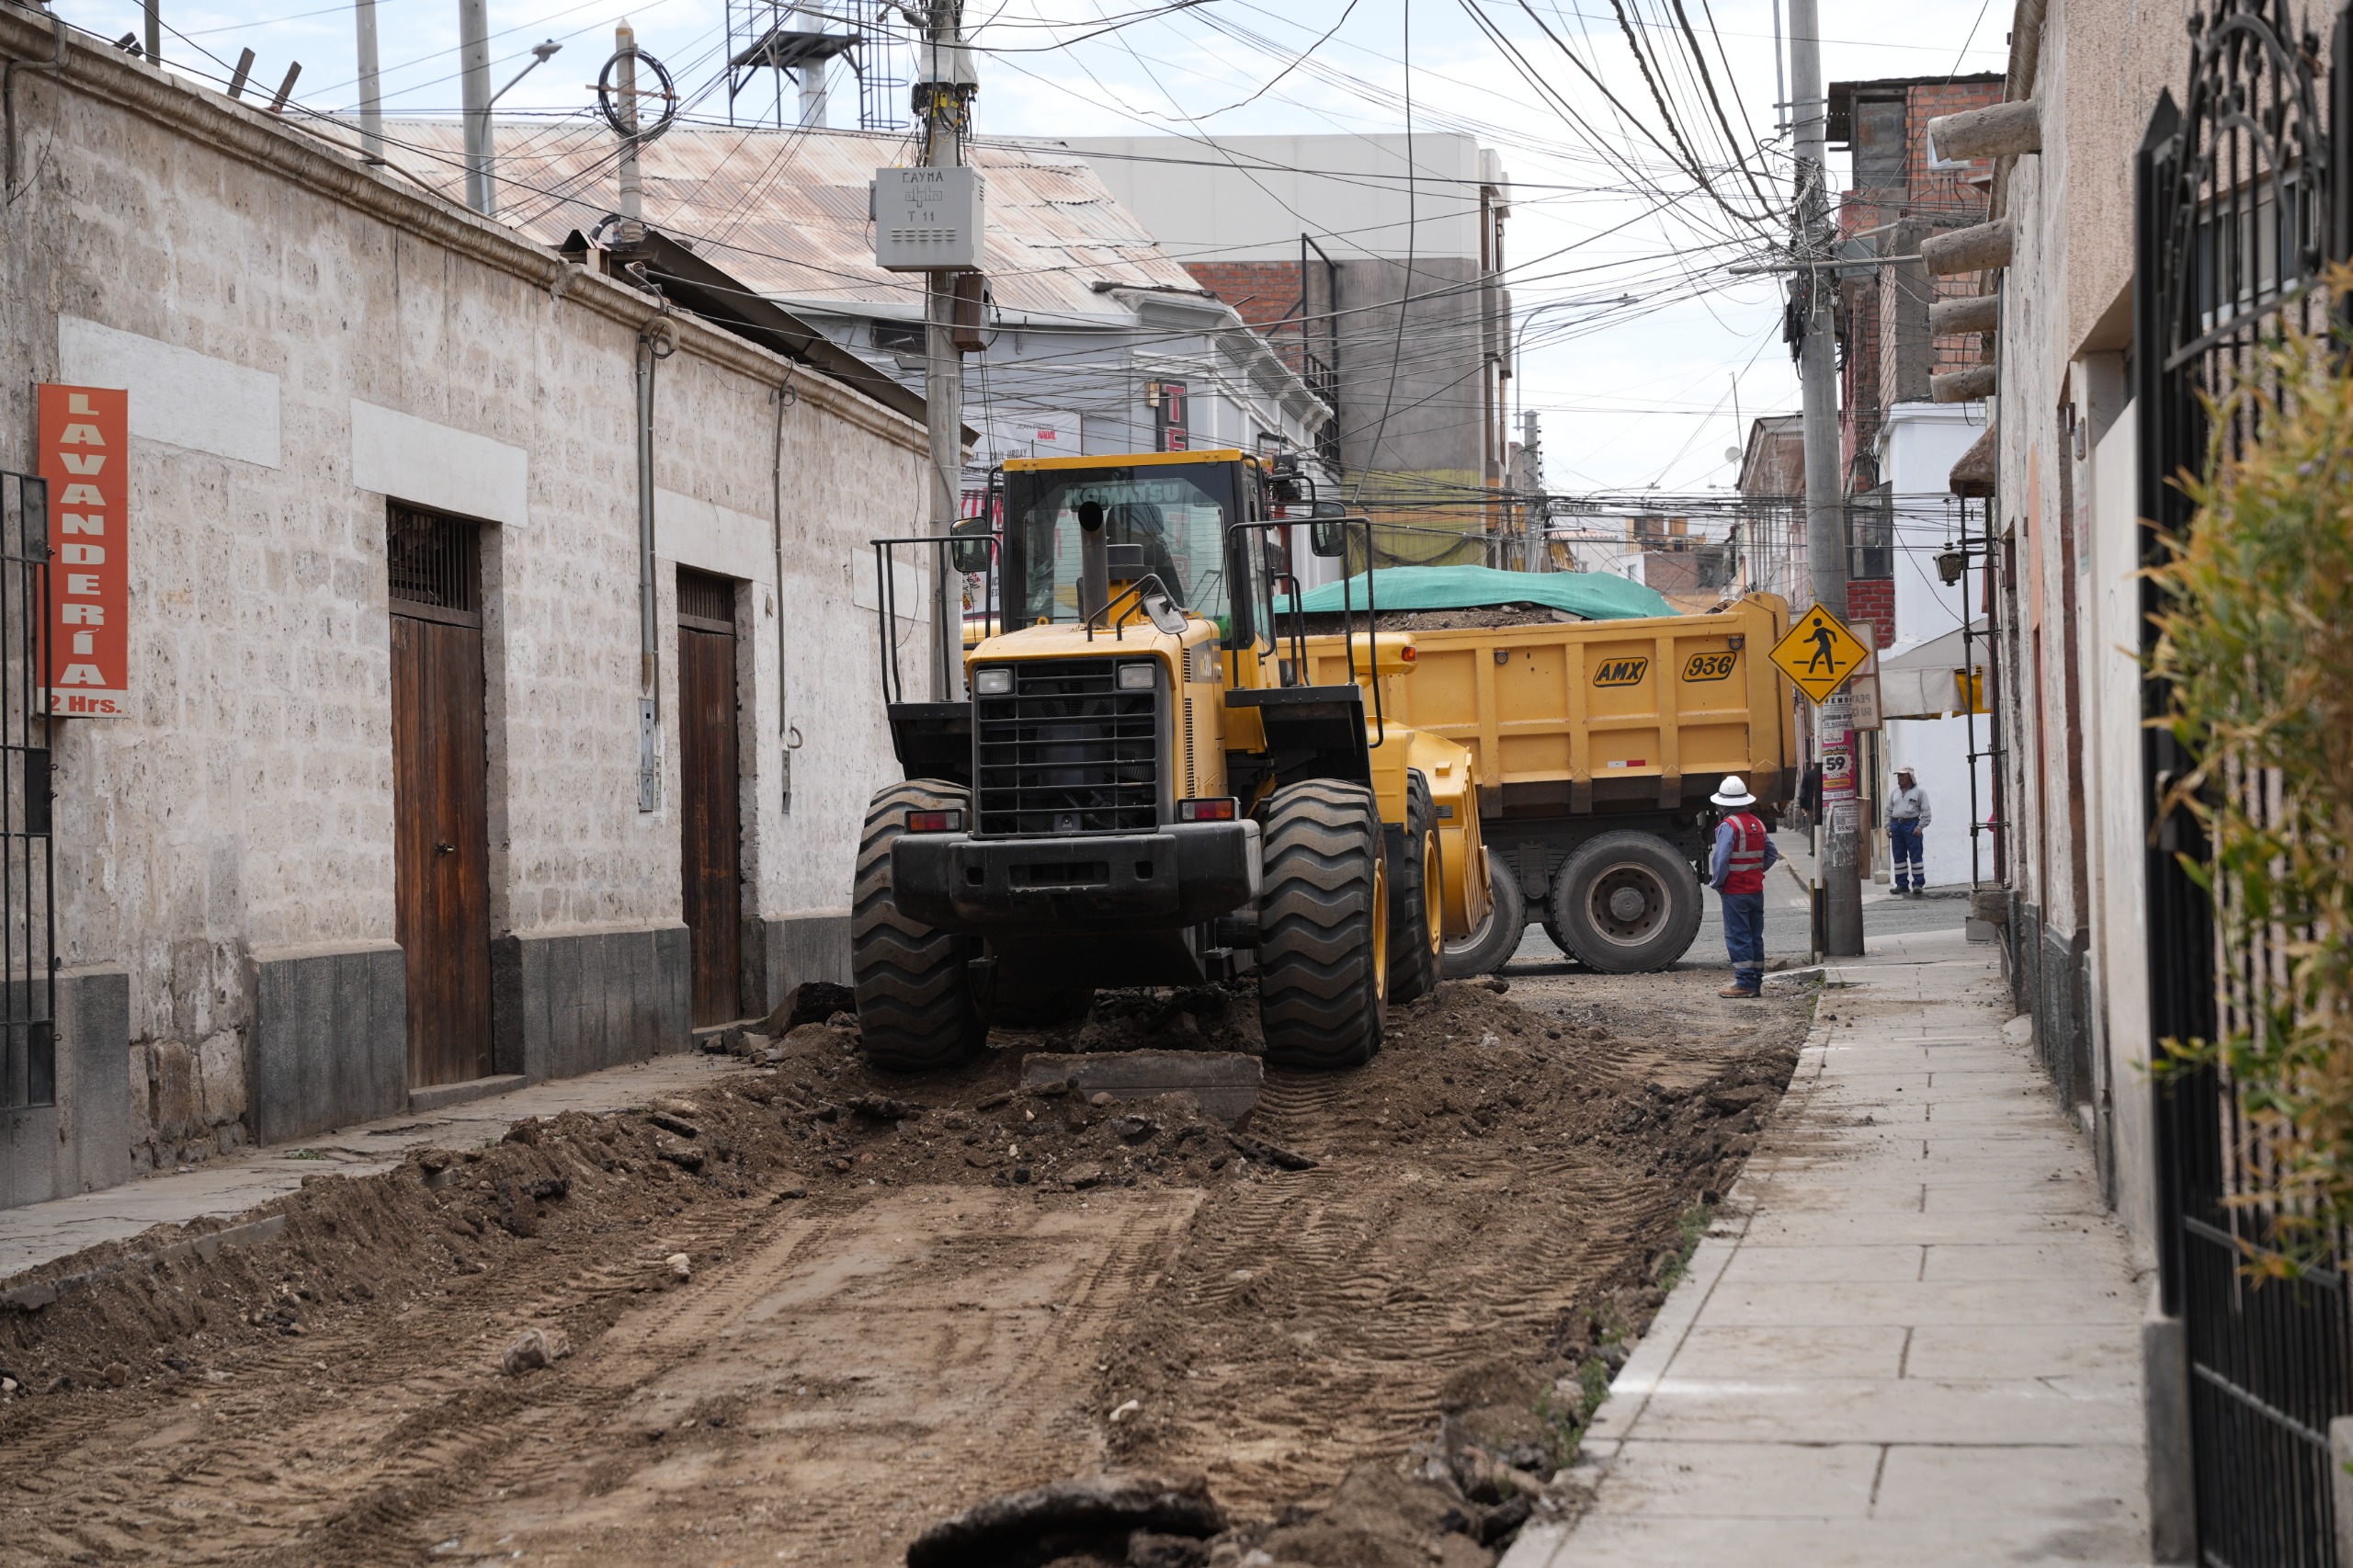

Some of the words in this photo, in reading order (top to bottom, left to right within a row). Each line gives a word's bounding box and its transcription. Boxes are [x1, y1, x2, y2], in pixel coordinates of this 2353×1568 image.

[903, 171, 943, 183] CAYMA
[908, 211, 915, 222] T
[923, 210, 935, 222] 11
[1064, 483, 1179, 506] KOMATSU
[59, 393, 107, 686] LAVANDERÍA
[1596, 661, 1644, 682] AMX
[69, 696, 121, 713] Hrs.
[1826, 756, 1845, 770] 59
